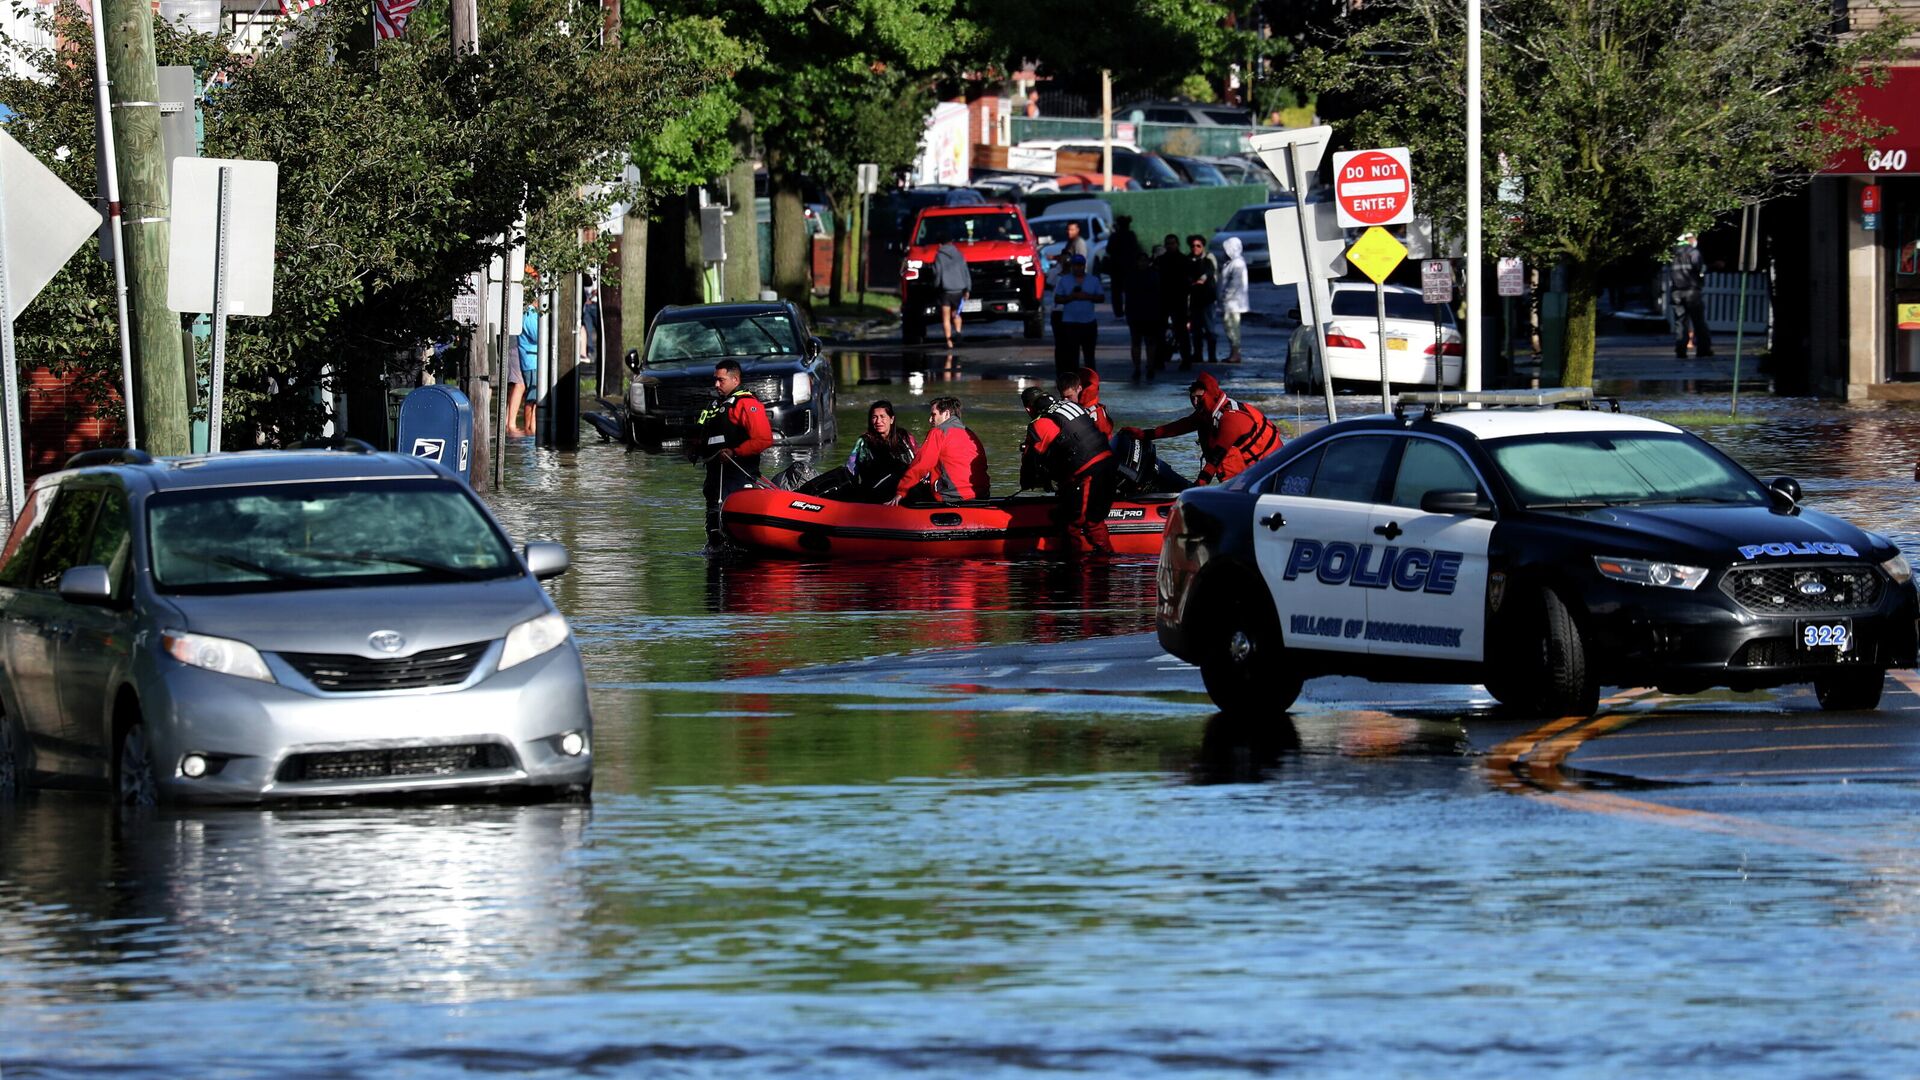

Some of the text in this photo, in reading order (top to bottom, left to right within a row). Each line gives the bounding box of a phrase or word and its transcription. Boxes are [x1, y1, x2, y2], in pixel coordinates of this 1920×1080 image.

[1868, 150, 1907, 171] 640
[1346, 163, 1398, 179] DO NOT
[1353, 197, 1396, 212] ENTER
[1430, 262, 1443, 273] NO
[1133, 439, 1141, 463] MERCUR
[1281, 475, 1309, 495] 322
[1108, 509, 1143, 520] MILPRO
[1738, 541, 1859, 560] POLICE
[1283, 538, 1464, 595] POLICE
[1290, 614, 1343, 637] VILLAGE
[1344, 618, 1364, 639] OF
[1804, 625, 1846, 646] 322
